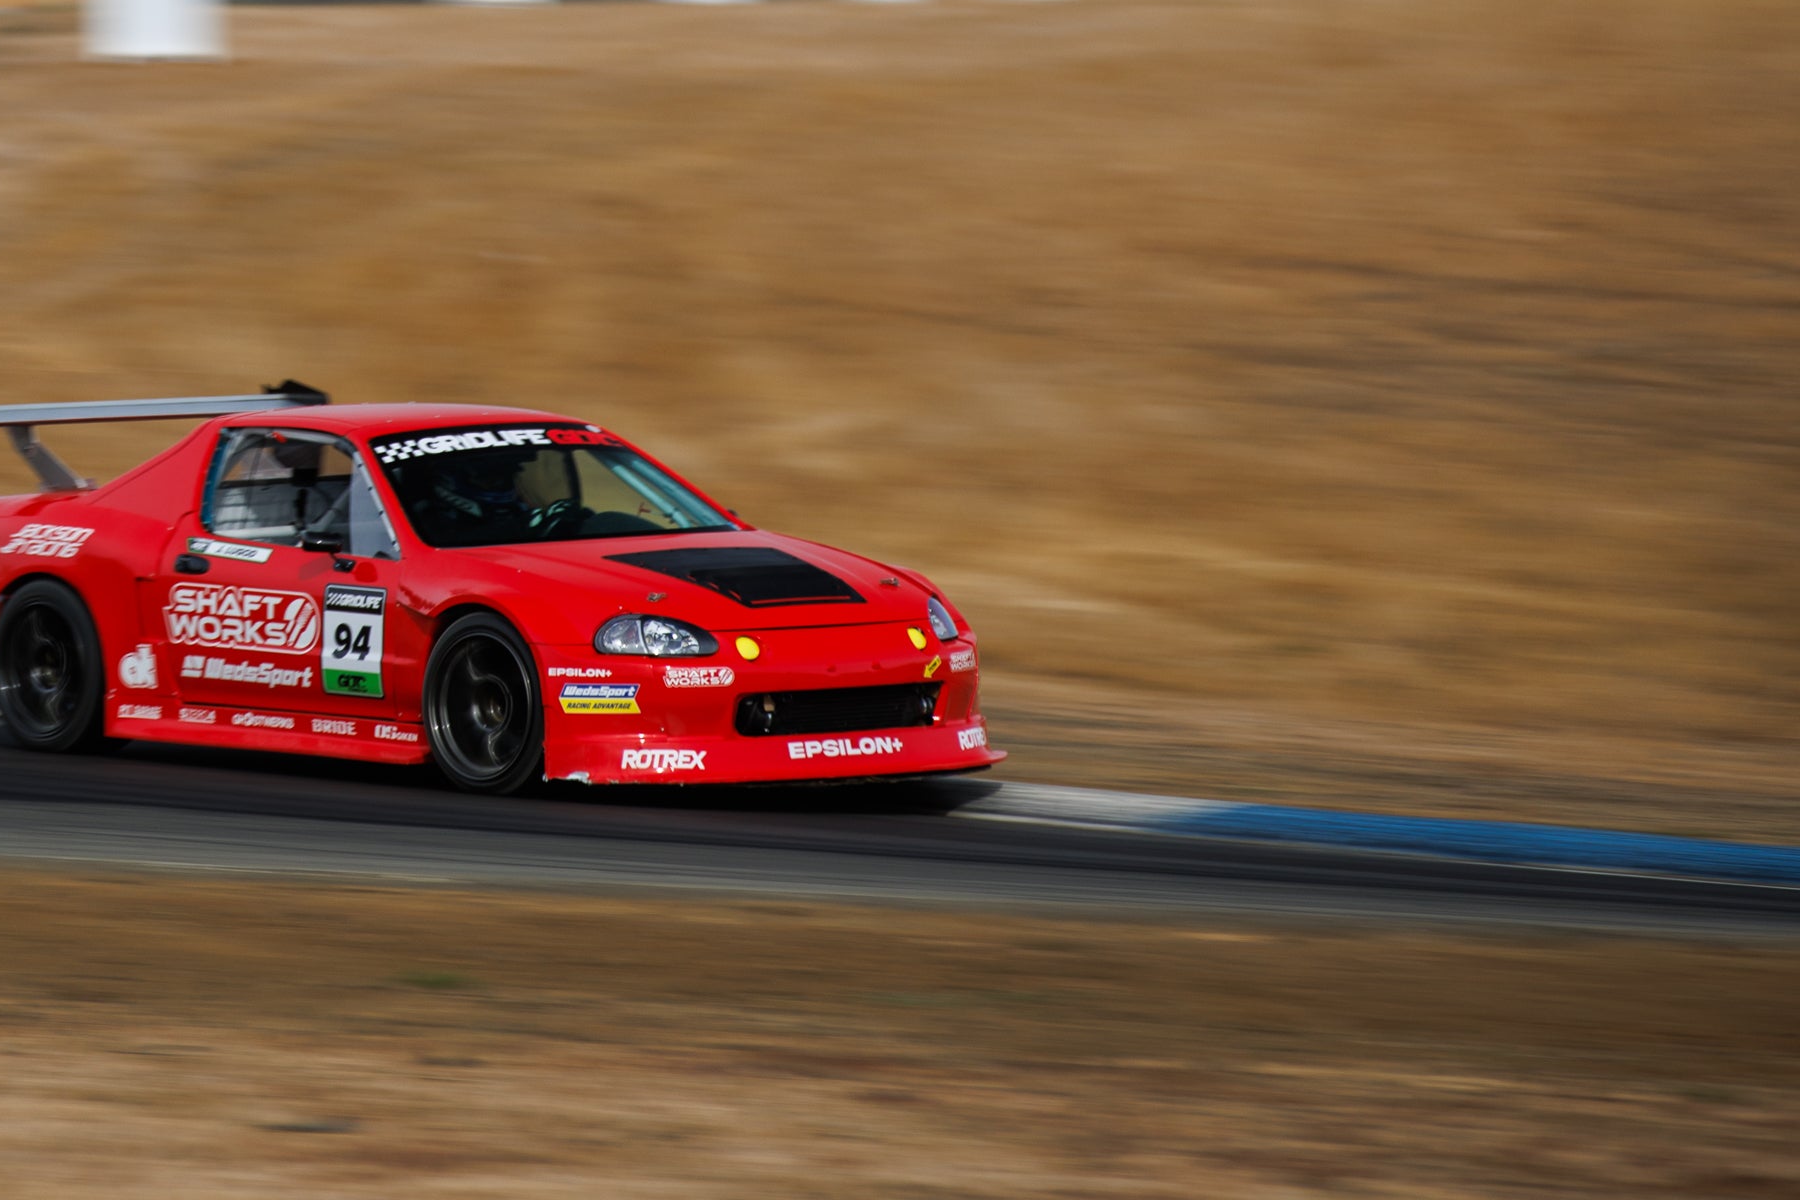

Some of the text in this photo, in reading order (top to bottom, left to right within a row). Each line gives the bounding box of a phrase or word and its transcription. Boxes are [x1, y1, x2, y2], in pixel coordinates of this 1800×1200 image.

[417, 429, 551, 454] GRIDLIFE
[173, 589, 284, 619] SHAFT
[169, 614, 287, 647] WORKS
[332, 623, 371, 660] 94
[203, 657, 313, 688] WedsSport
[548, 667, 612, 678] EPSILON+
[665, 676, 719, 686] WORKS
[667, 669, 718, 678] SHAFT
[563, 686, 637, 699] WedsSport
[312, 718, 357, 736] BRIDE
[788, 737, 903, 760] EPSILON+
[621, 749, 707, 771] ROTREX
